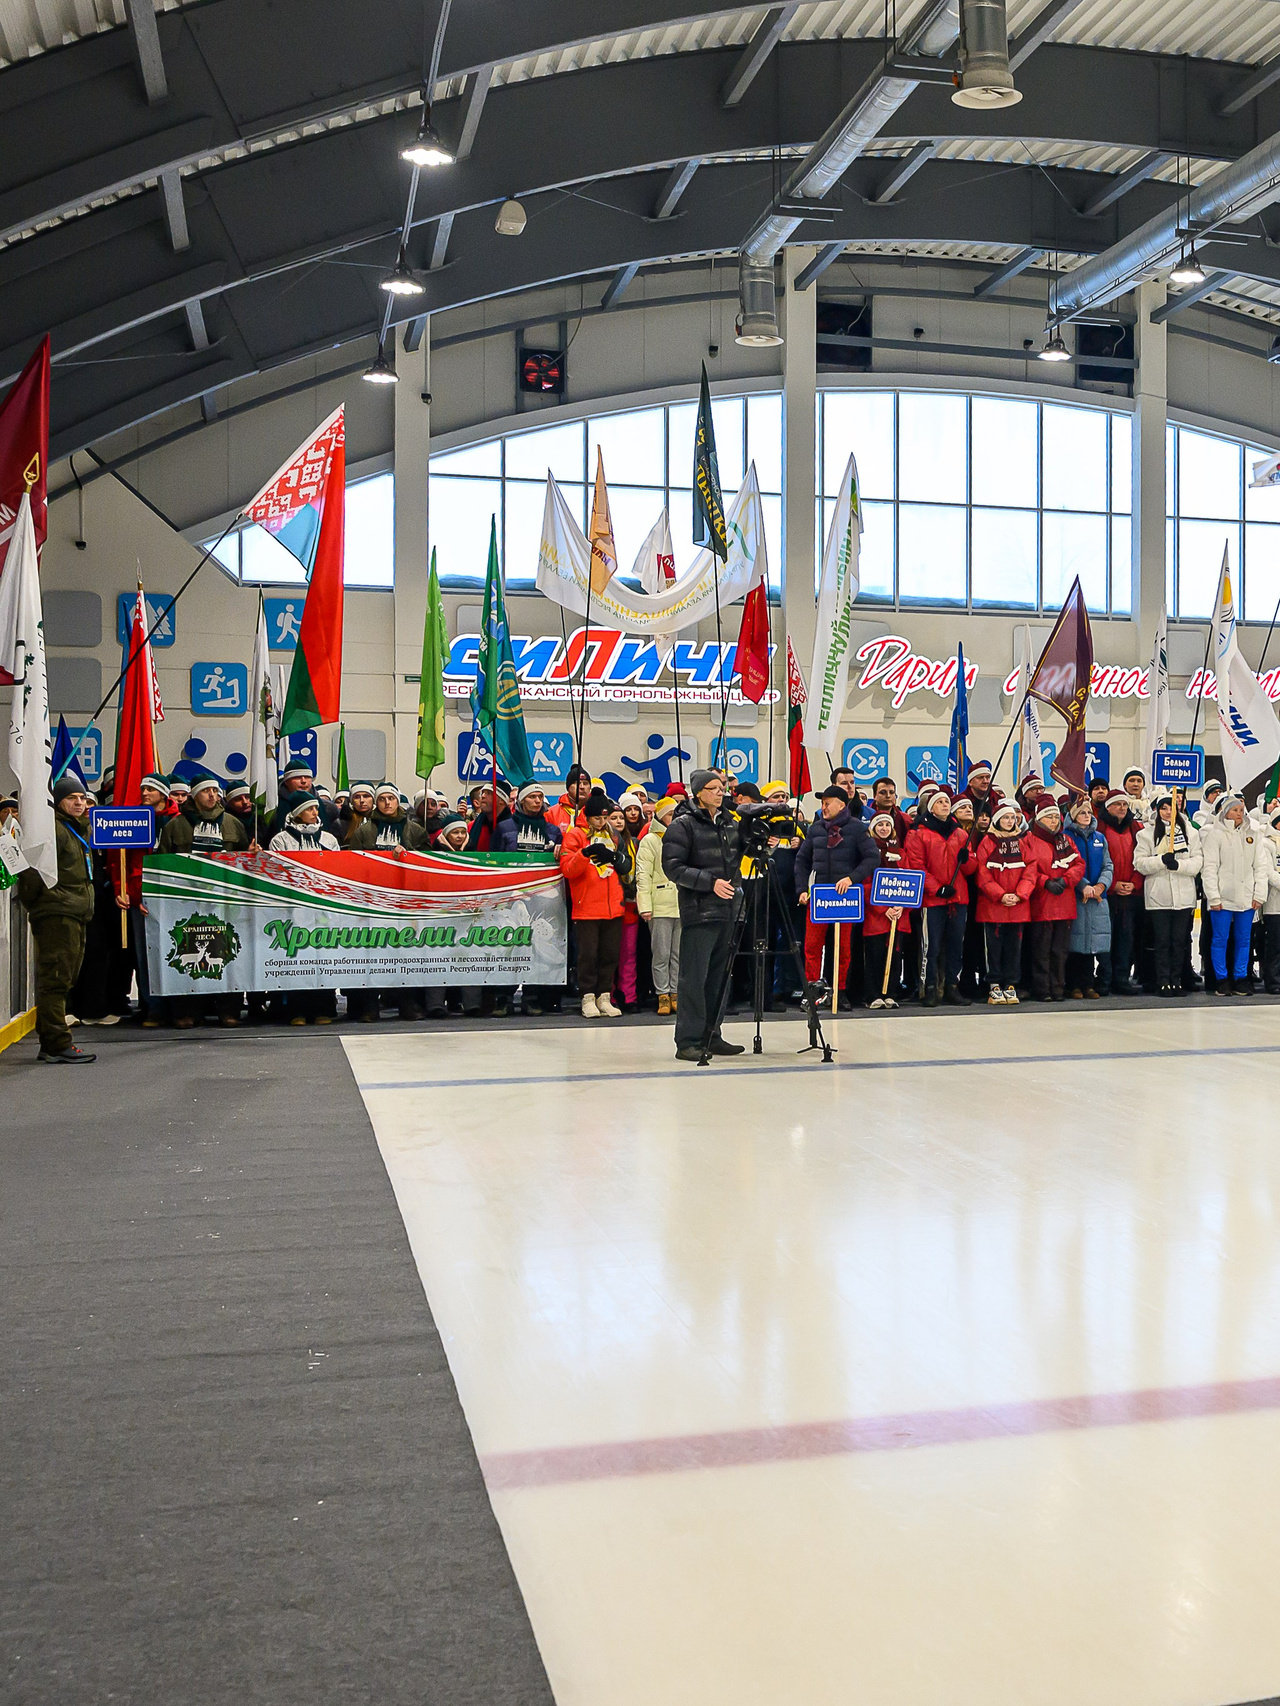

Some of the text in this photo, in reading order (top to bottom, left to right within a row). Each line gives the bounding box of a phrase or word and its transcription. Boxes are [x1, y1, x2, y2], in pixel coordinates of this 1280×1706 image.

[860, 638, 976, 706] Дарим
[442, 685, 778, 703] РЕСКАНСКИЙ ГОРНОЛЫЖНЫЙ ЦТР
[868, 755, 886, 768] 24
[1164, 756, 1190, 767] Белые
[1162, 769, 1191, 779] тигры
[96, 818, 148, 831] Хранители
[113, 829, 132, 837] леса
[816, 898, 859, 909] Агрохолдинг
[182, 925, 227, 934] ХРАНИТЕЛИ
[195, 933, 216, 941] ЛЕСА
[263, 918, 533, 958] Хранители леса
[264, 957, 298, 967] сборная
[299, 956, 333, 966] команда
[333, 957, 378, 966] работников
[378, 956, 450, 965] природоохранных
[457, 954, 531, 964] лесохозяйственных
[264, 962, 531, 979] учреждений Управления делами Президента Республики Беларусь
